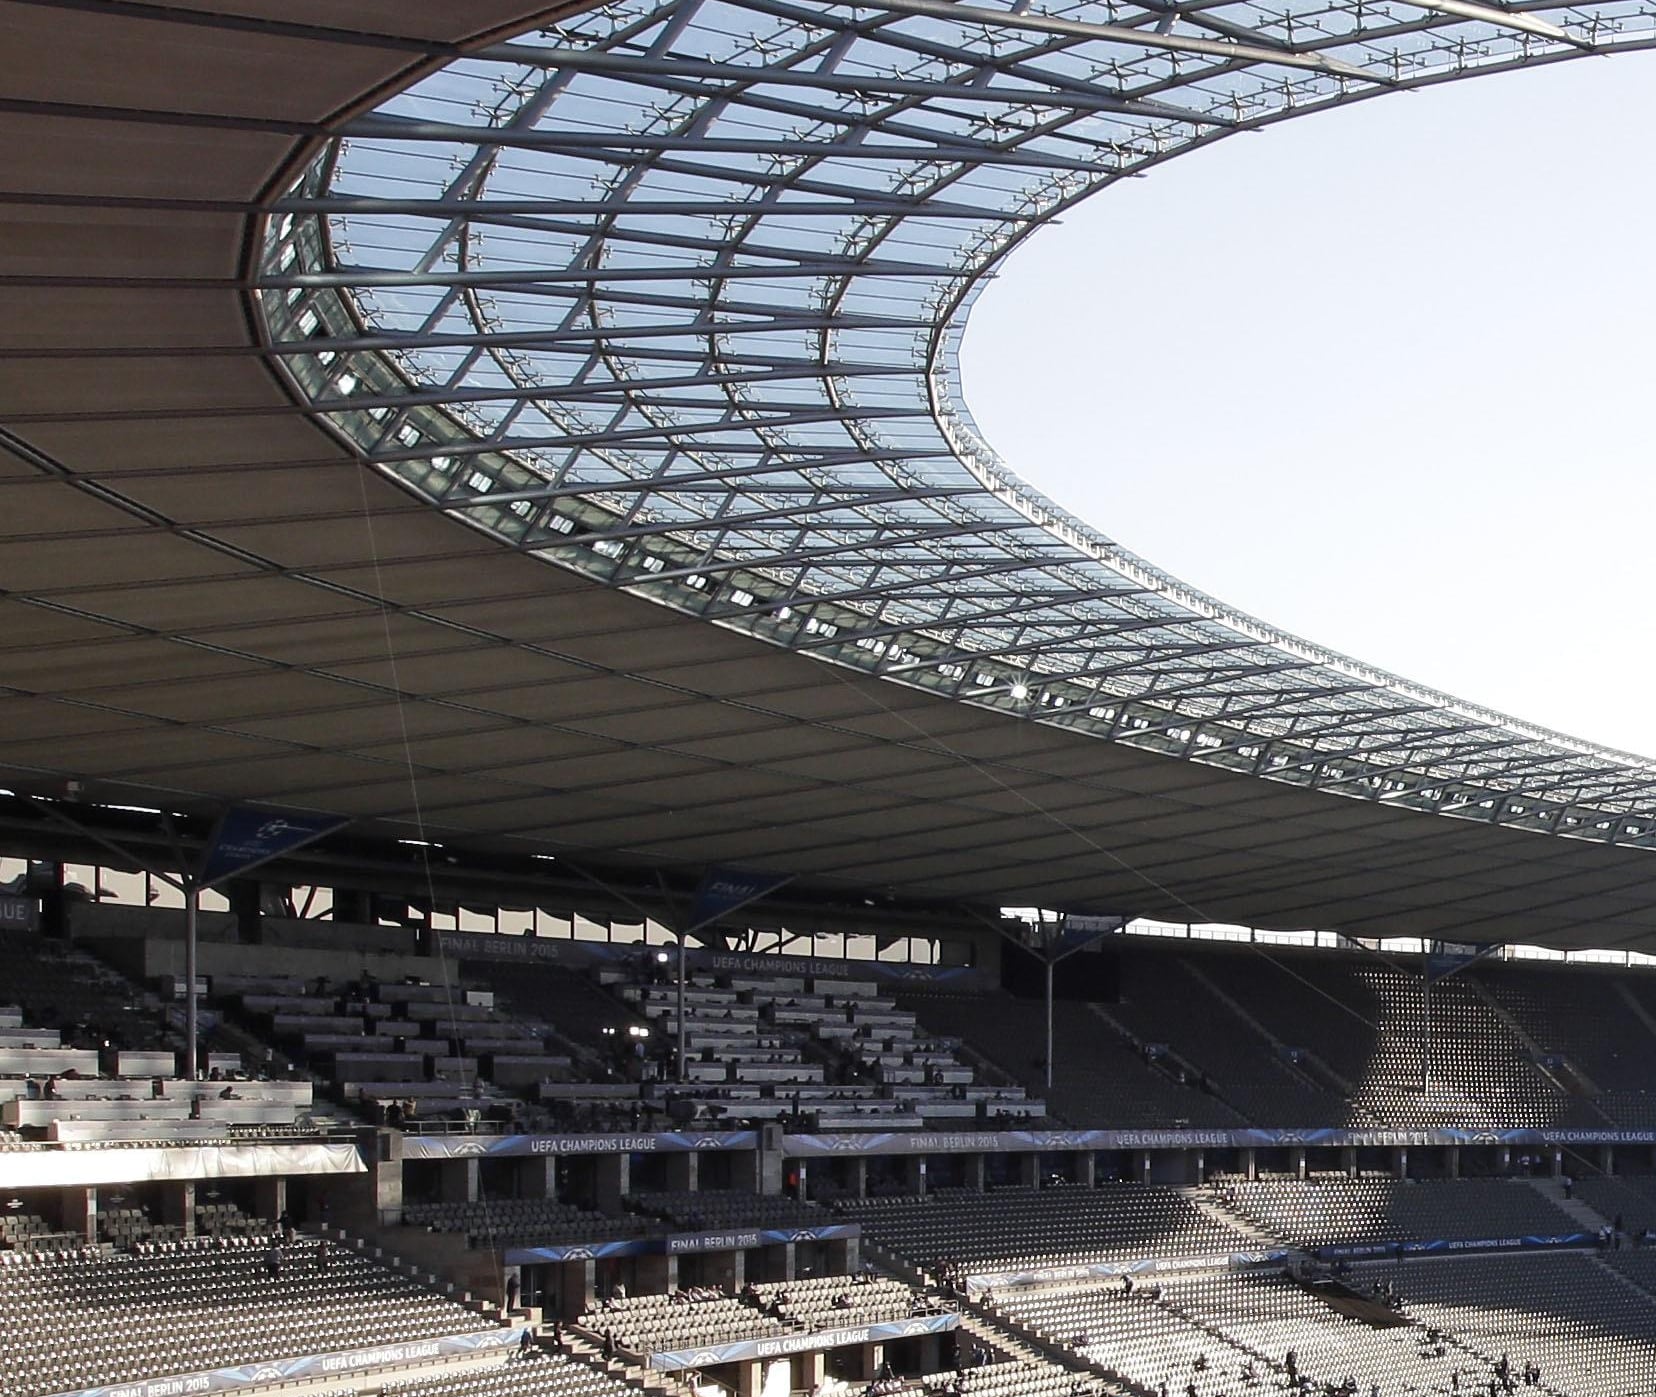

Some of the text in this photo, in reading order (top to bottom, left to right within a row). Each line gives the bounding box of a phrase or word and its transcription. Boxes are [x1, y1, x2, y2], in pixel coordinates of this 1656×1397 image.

[484, 940, 527, 956] BERLIN
[712, 956, 848, 976] UEFA CHAMPIONS LEAGUE
[910, 1137, 940, 1148] FINAL
[943, 1136, 976, 1149] BERLIN
[1116, 1133, 1227, 1145] UEFA CHAMPIONS LEAGUE
[1542, 1131, 1655, 1142] UEFA CHAMPIONS LEAGUE
[531, 1138, 656, 1152] UEFA CHAMPIONS LEAGUE
[671, 1234, 758, 1251] FINAL BERLIN 2015
[757, 1329, 869, 1355] UEFA CHAMPIONS LEAGUE
[322, 1343, 440, 1371] UEFA CHAMPIONS LEAGUE
[185, 1377, 211, 1393] 2015
